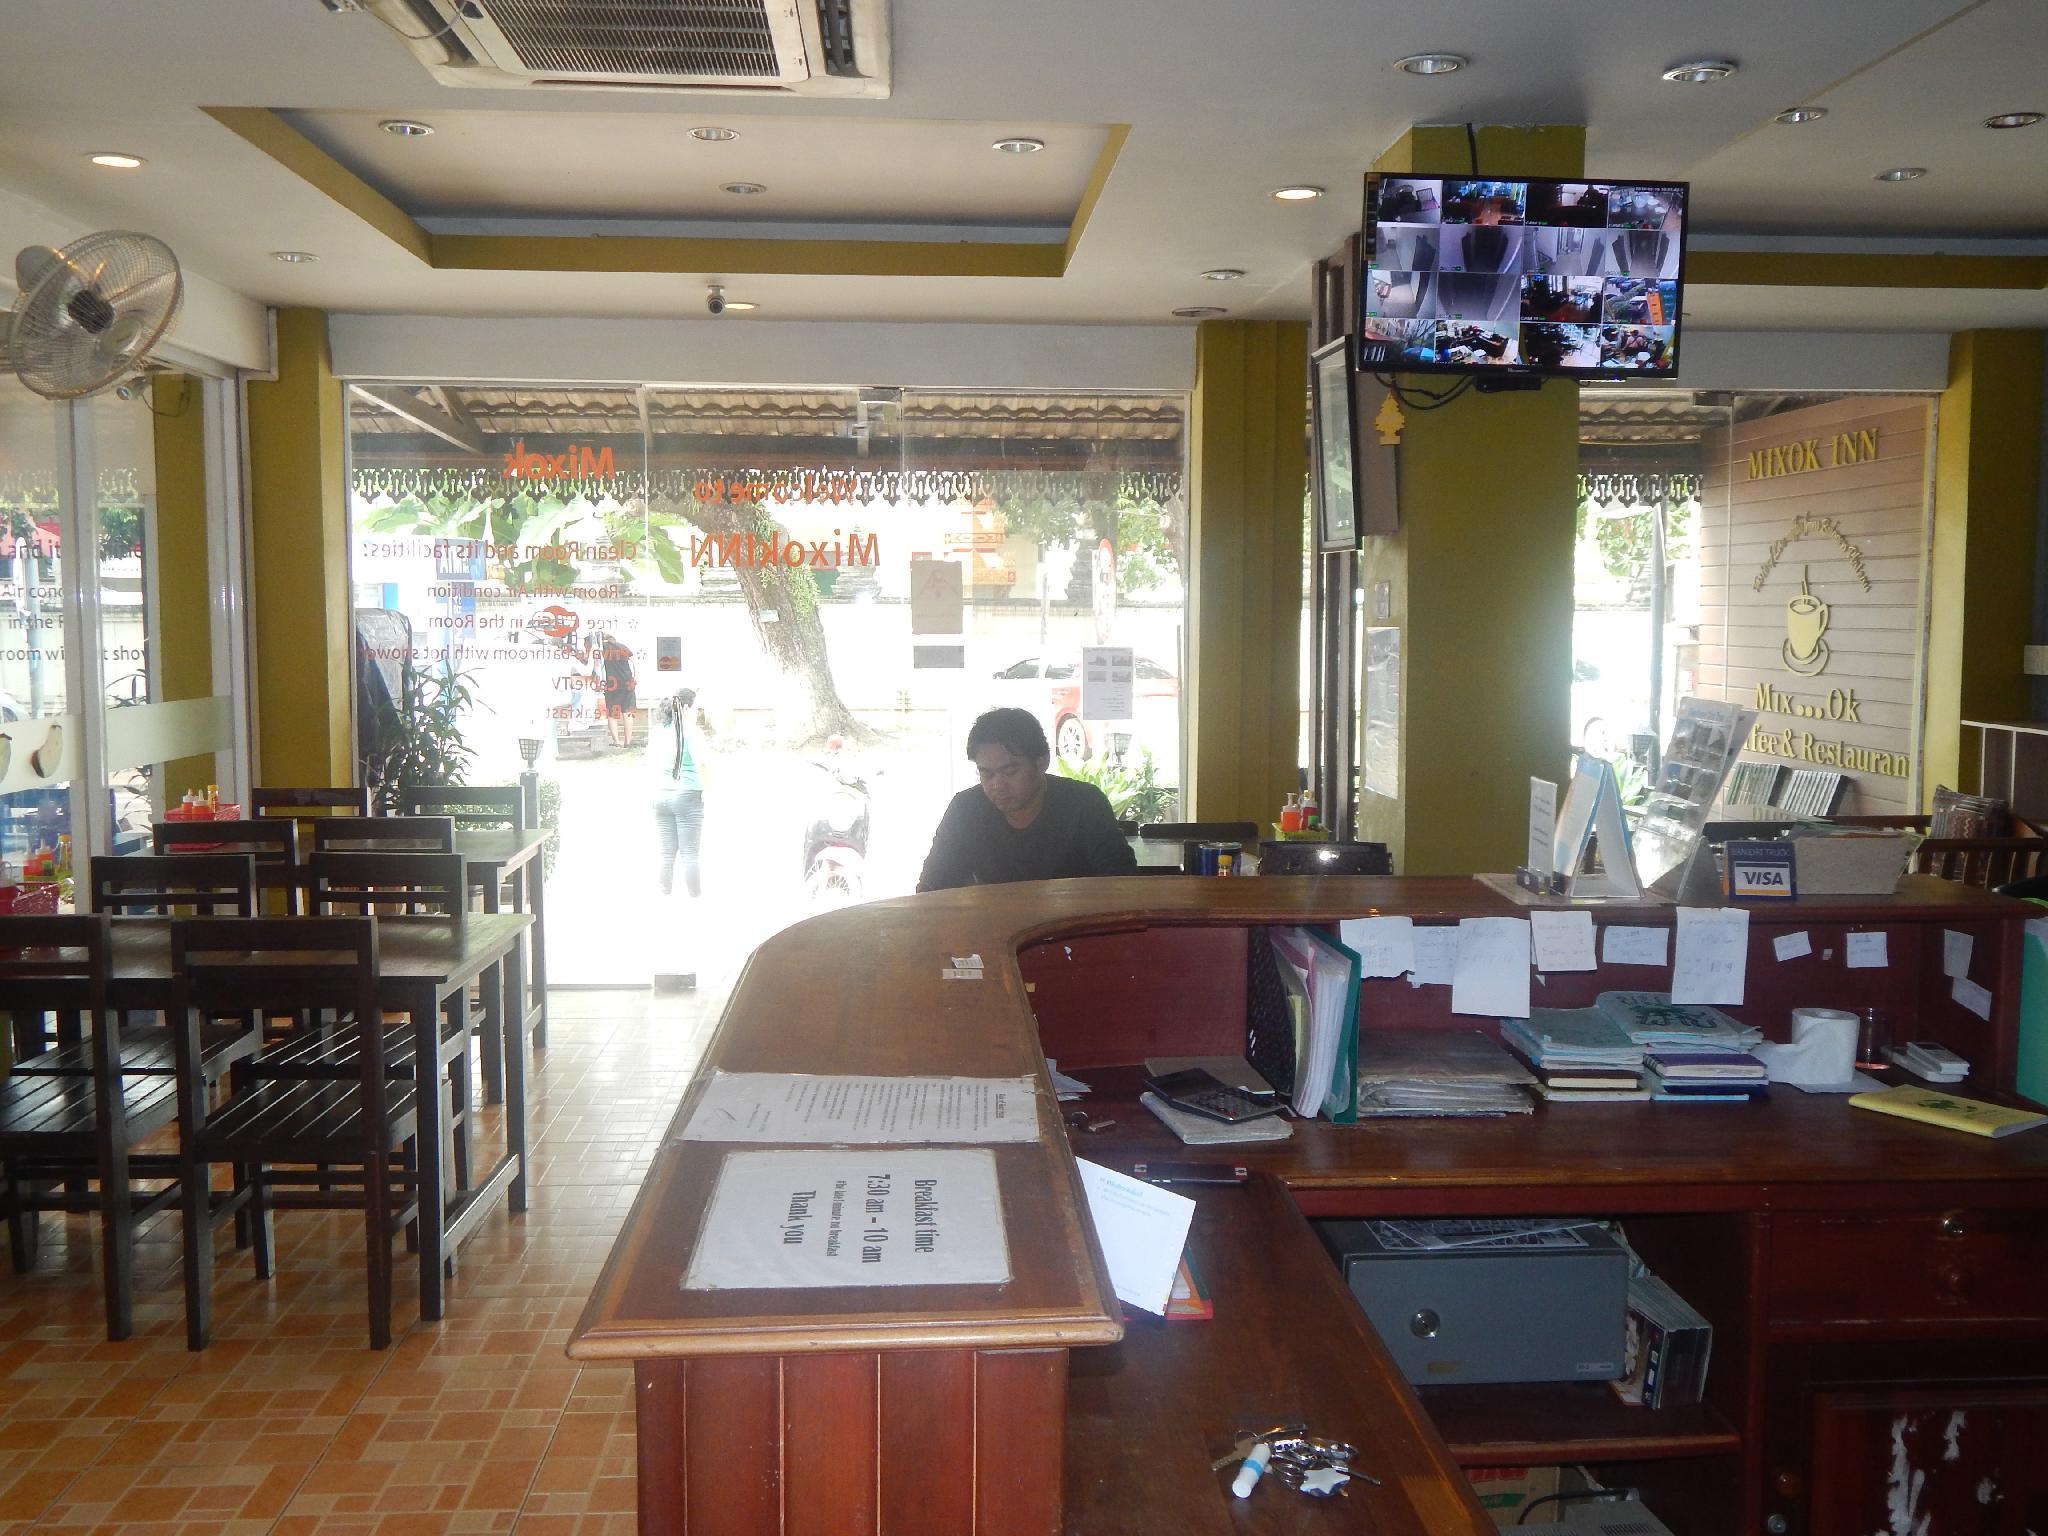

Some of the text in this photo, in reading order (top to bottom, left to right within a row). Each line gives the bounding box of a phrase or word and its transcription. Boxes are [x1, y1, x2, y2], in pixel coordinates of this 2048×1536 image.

[1748, 427, 1879, 481] MIXOK INN
[1, 583, 24, 598] Air
[8, 614, 21, 629] in
[1782, 728, 1797, 759] &
[1800, 731, 1911, 778] Restauran
[1742, 871, 1784, 886] VISA
[866, 1173, 891, 1196] 7:30
[865, 1198, 885, 1213] am
[779, 1190, 817, 1245] Thank you
[829, 1221, 841, 1229] no
[914, 1179, 941, 1253] Breakfast time
[826, 1229, 843, 1257] breakfast
[863, 1228, 889, 1242] 10
[861, 1245, 882, 1263] am
